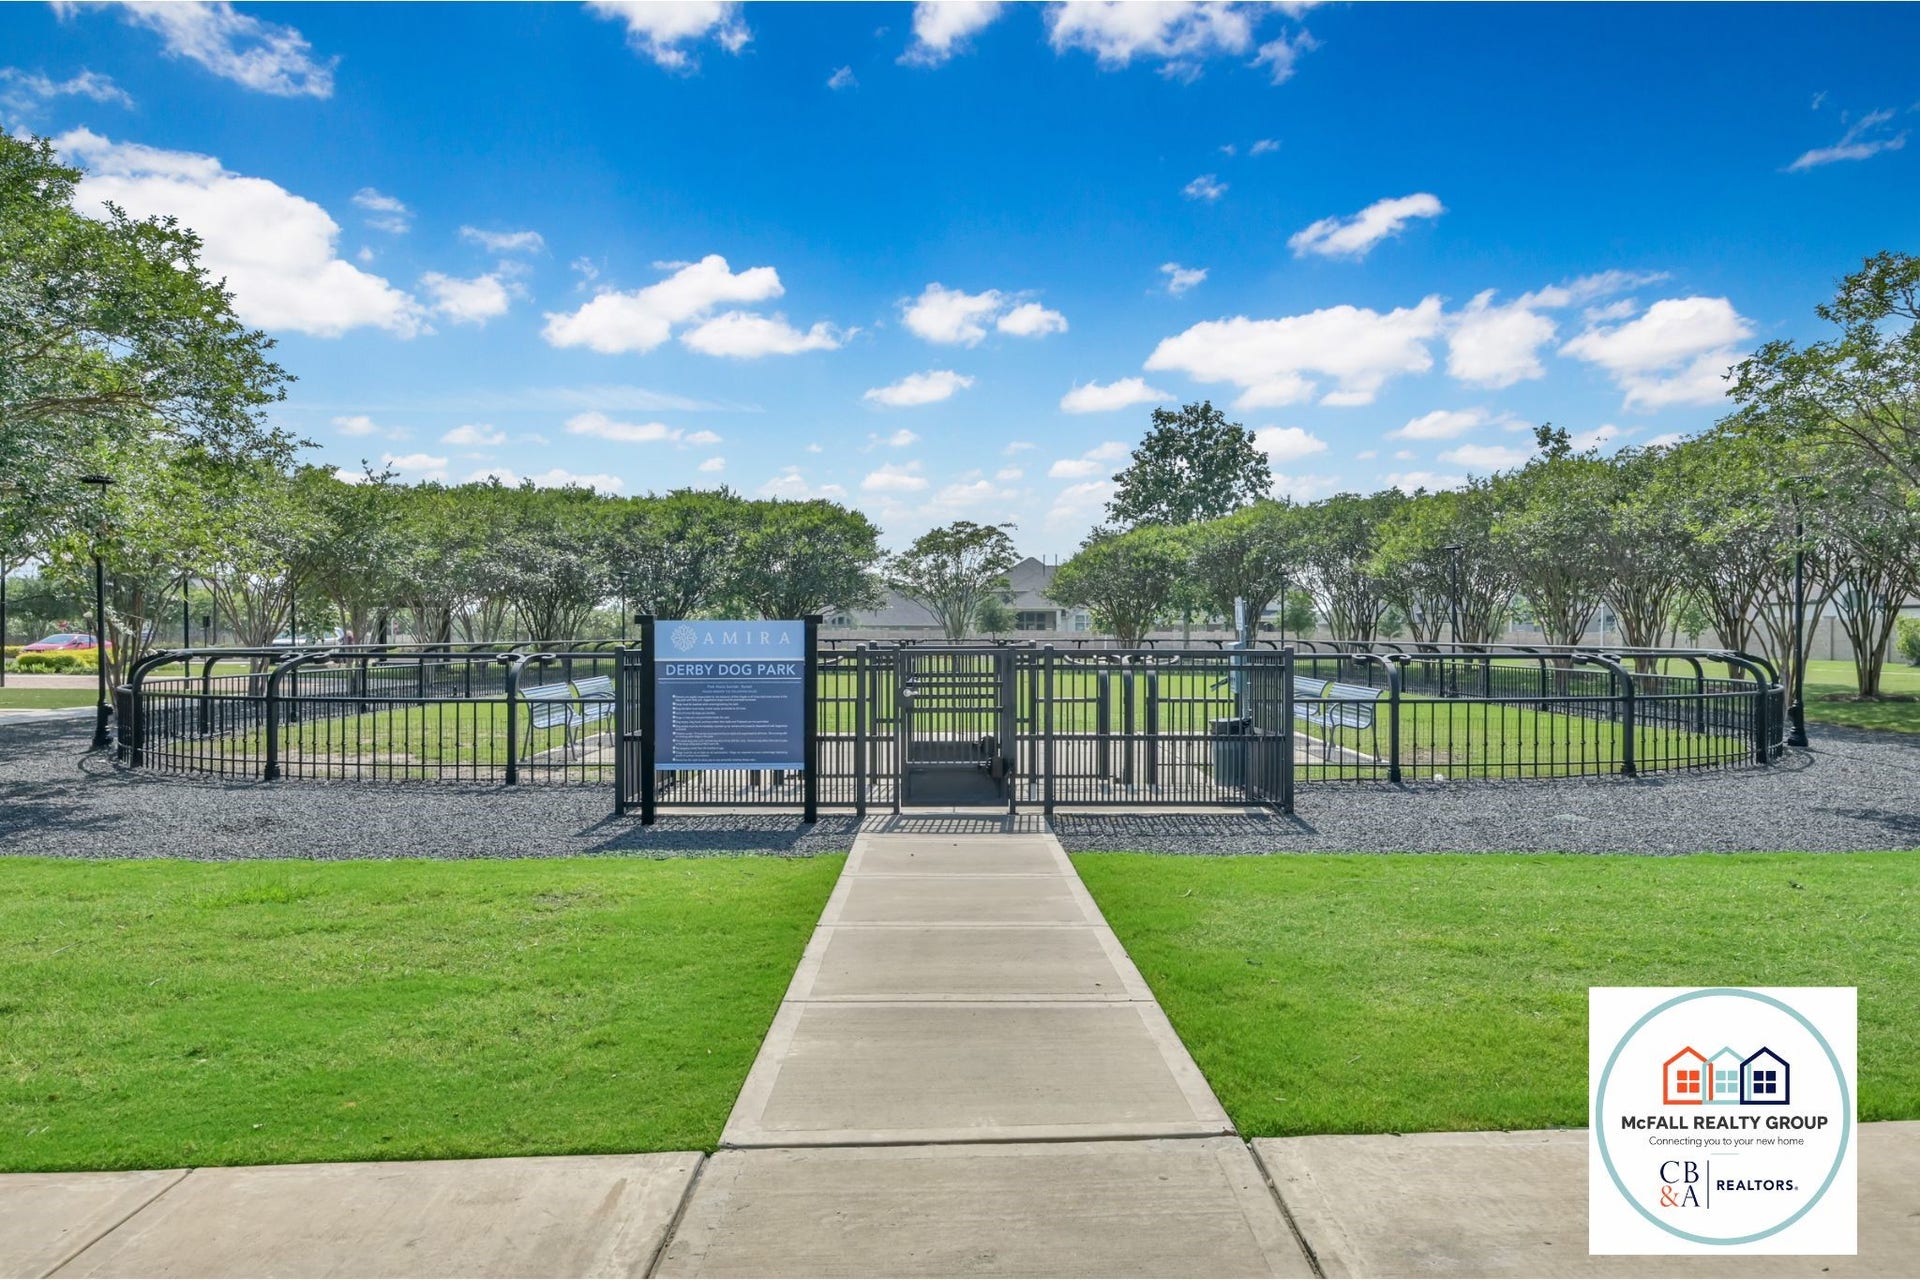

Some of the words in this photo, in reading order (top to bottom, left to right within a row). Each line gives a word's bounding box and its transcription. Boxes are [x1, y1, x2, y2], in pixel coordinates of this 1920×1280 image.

[704, 631, 790, 644] AMIRA
[666, 664, 713, 676] DERBY
[718, 664, 752, 676] DOG
[757, 664, 796, 676] PARK
